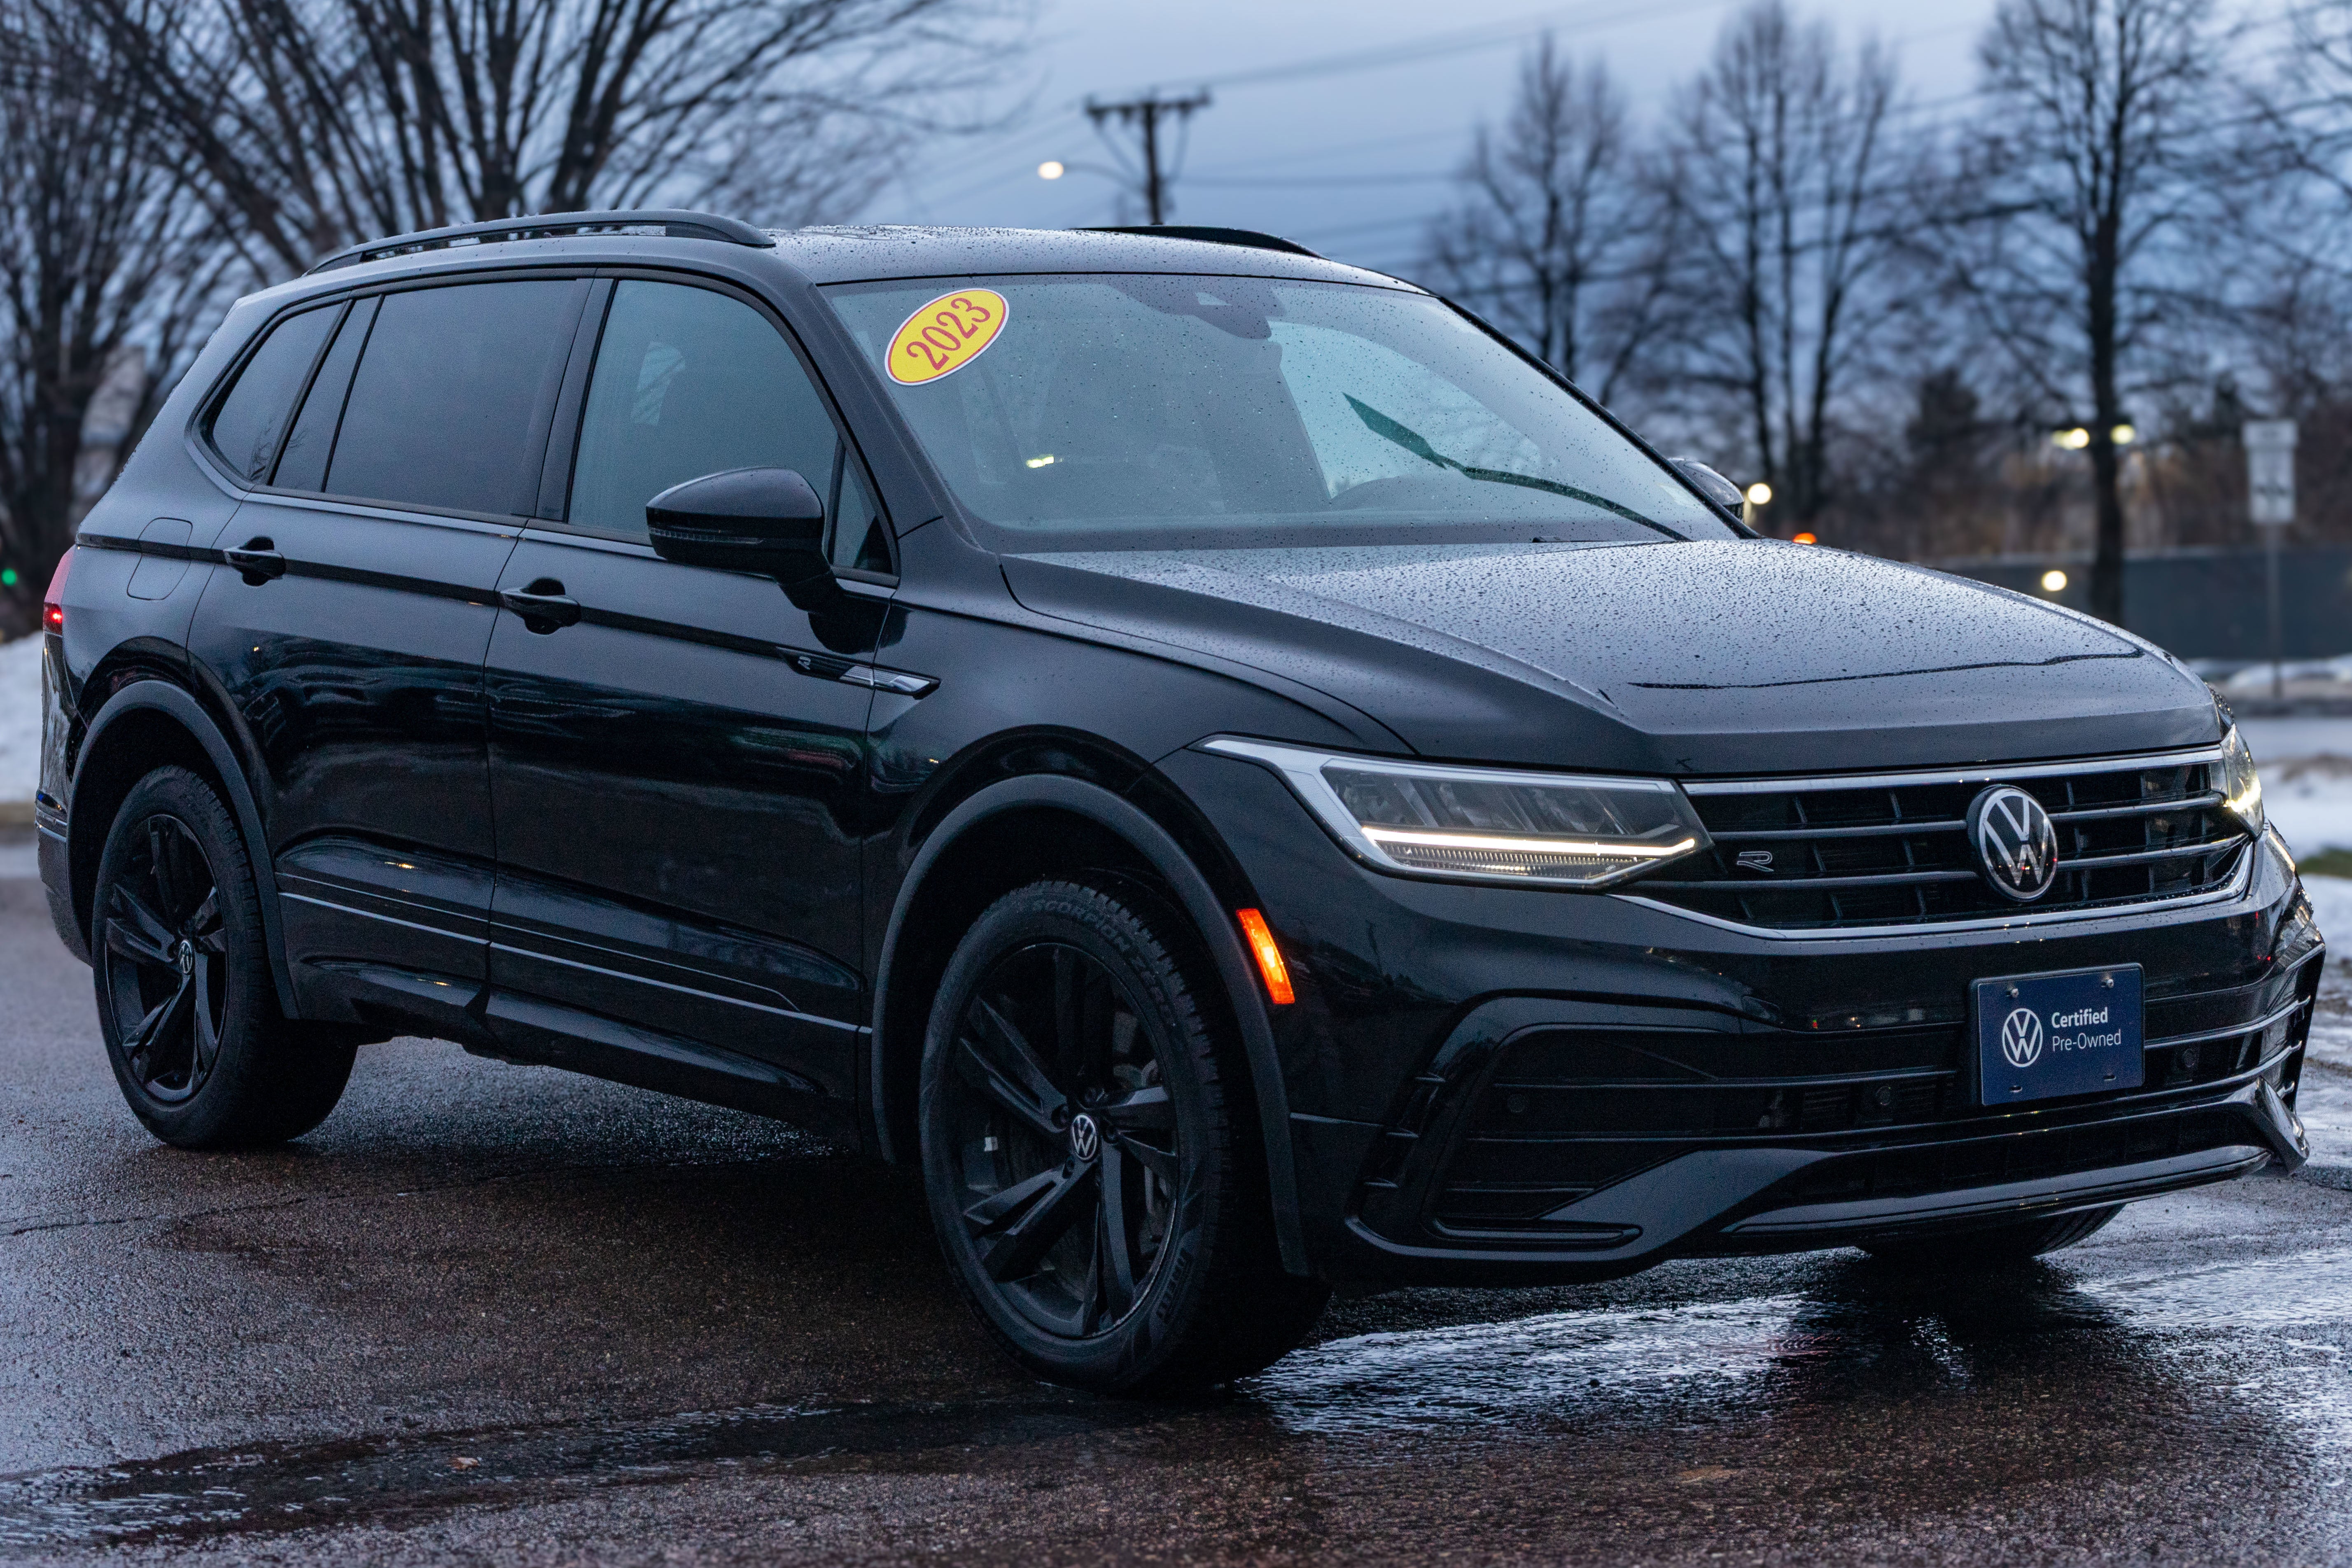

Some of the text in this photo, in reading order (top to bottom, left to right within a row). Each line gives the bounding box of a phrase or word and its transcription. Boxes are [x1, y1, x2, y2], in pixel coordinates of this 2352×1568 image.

[906, 298, 990, 370] 2023
[1737, 851, 1773, 872] R
[1979, 788, 2058, 899] VW
[1032, 899, 1131, 952] SCORPION
[2002, 1008, 2043, 1067] VW
[2051, 1007, 2108, 1029] Certified
[2052, 1029, 2121, 1052] Pre-Owned
[1156, 1248, 1194, 1324] PIRELLI
